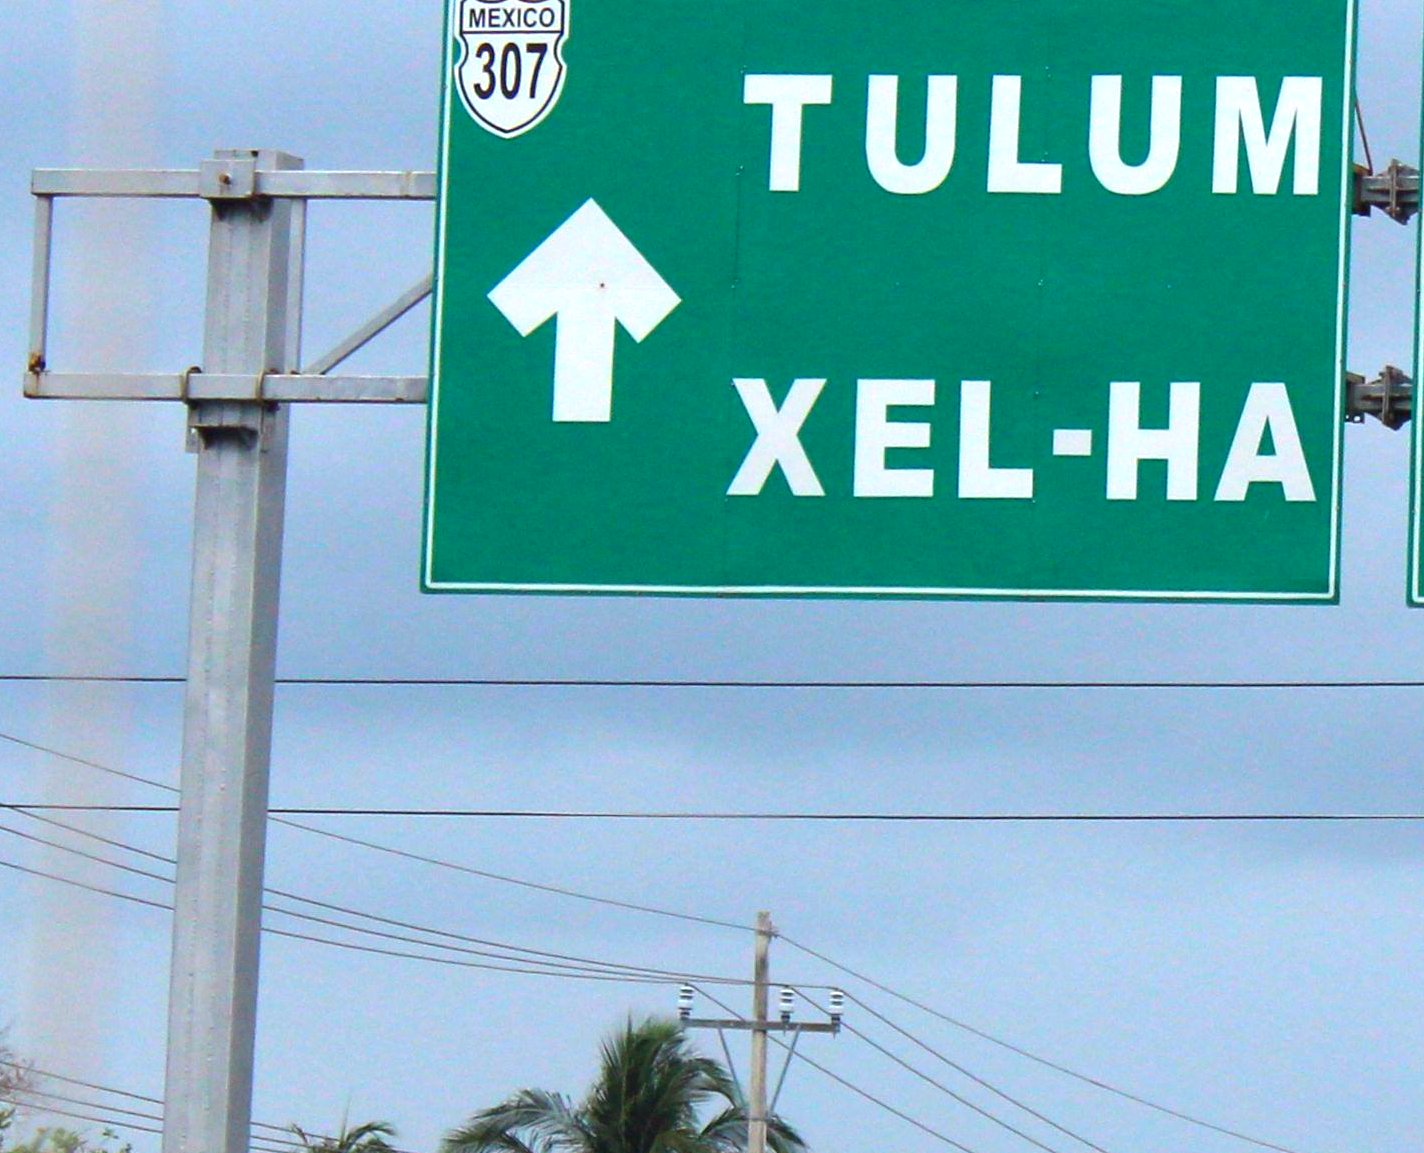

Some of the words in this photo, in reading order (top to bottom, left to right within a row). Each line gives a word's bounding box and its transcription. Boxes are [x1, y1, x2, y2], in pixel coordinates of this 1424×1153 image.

[468, 7, 556, 29] MEXICO
[473, 42, 549, 101] 307
[743, 73, 1322, 196] TULUM
[726, 377, 1317, 503] XEL-HA
